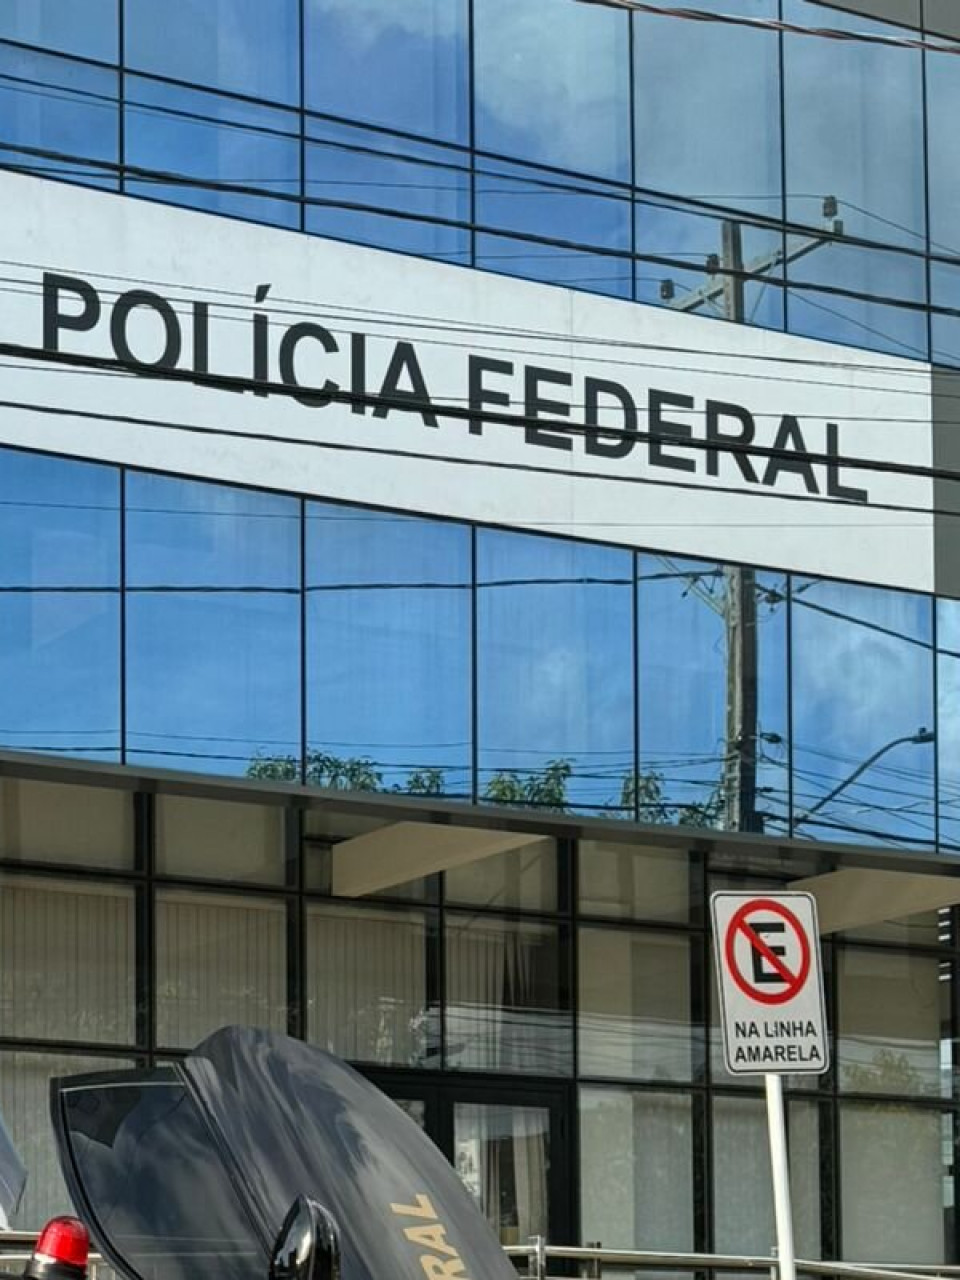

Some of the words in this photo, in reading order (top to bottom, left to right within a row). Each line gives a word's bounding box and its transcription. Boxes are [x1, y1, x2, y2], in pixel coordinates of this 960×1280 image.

[42, 271, 439, 428] POLÍCIA
[468, 354, 869, 505] FEDERAL
[735, 1021, 760, 1038] NA
[765, 1021, 817, 1038] LINHA
[735, 1045, 822, 1063] AMARELA
